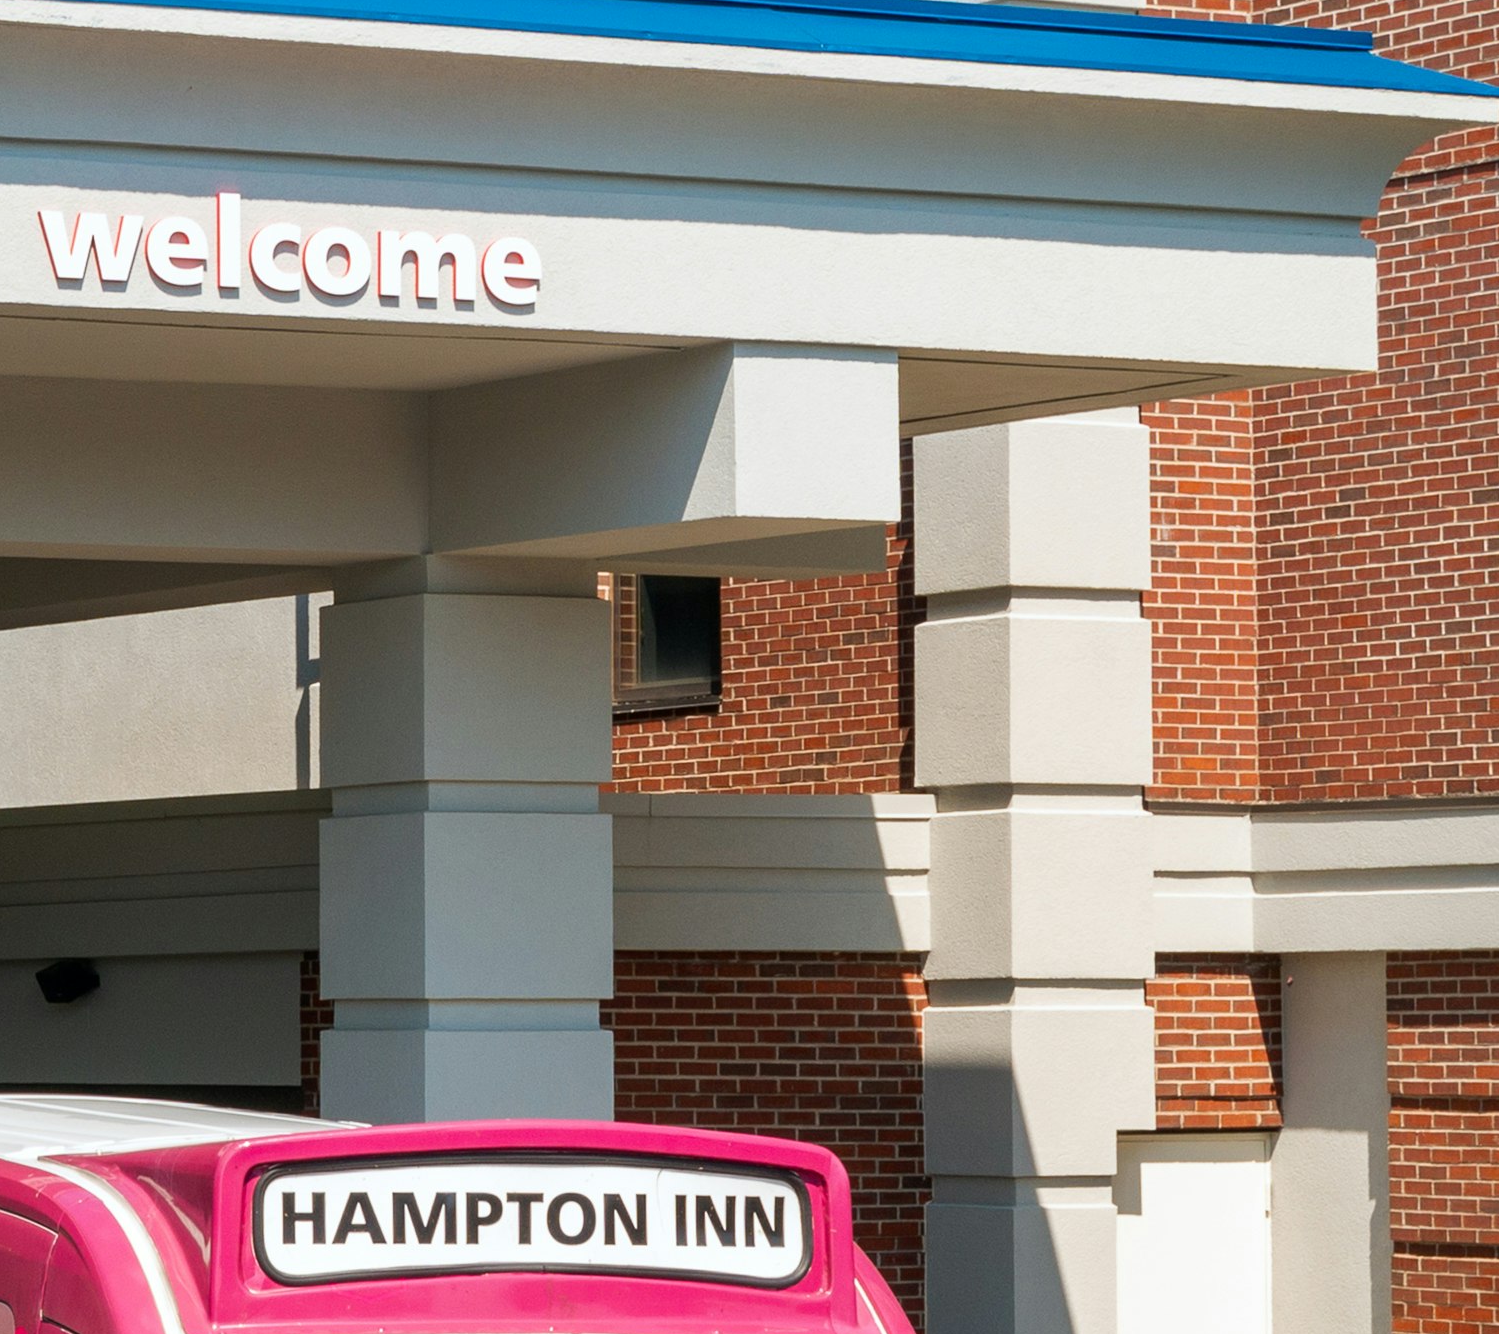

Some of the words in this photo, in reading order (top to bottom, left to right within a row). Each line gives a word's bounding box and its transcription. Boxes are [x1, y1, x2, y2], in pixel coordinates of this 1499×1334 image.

[38, 192, 542, 306] welcome
[281, 1191, 648, 1246] HAMPTON
[675, 1194, 785, 1248] INN
